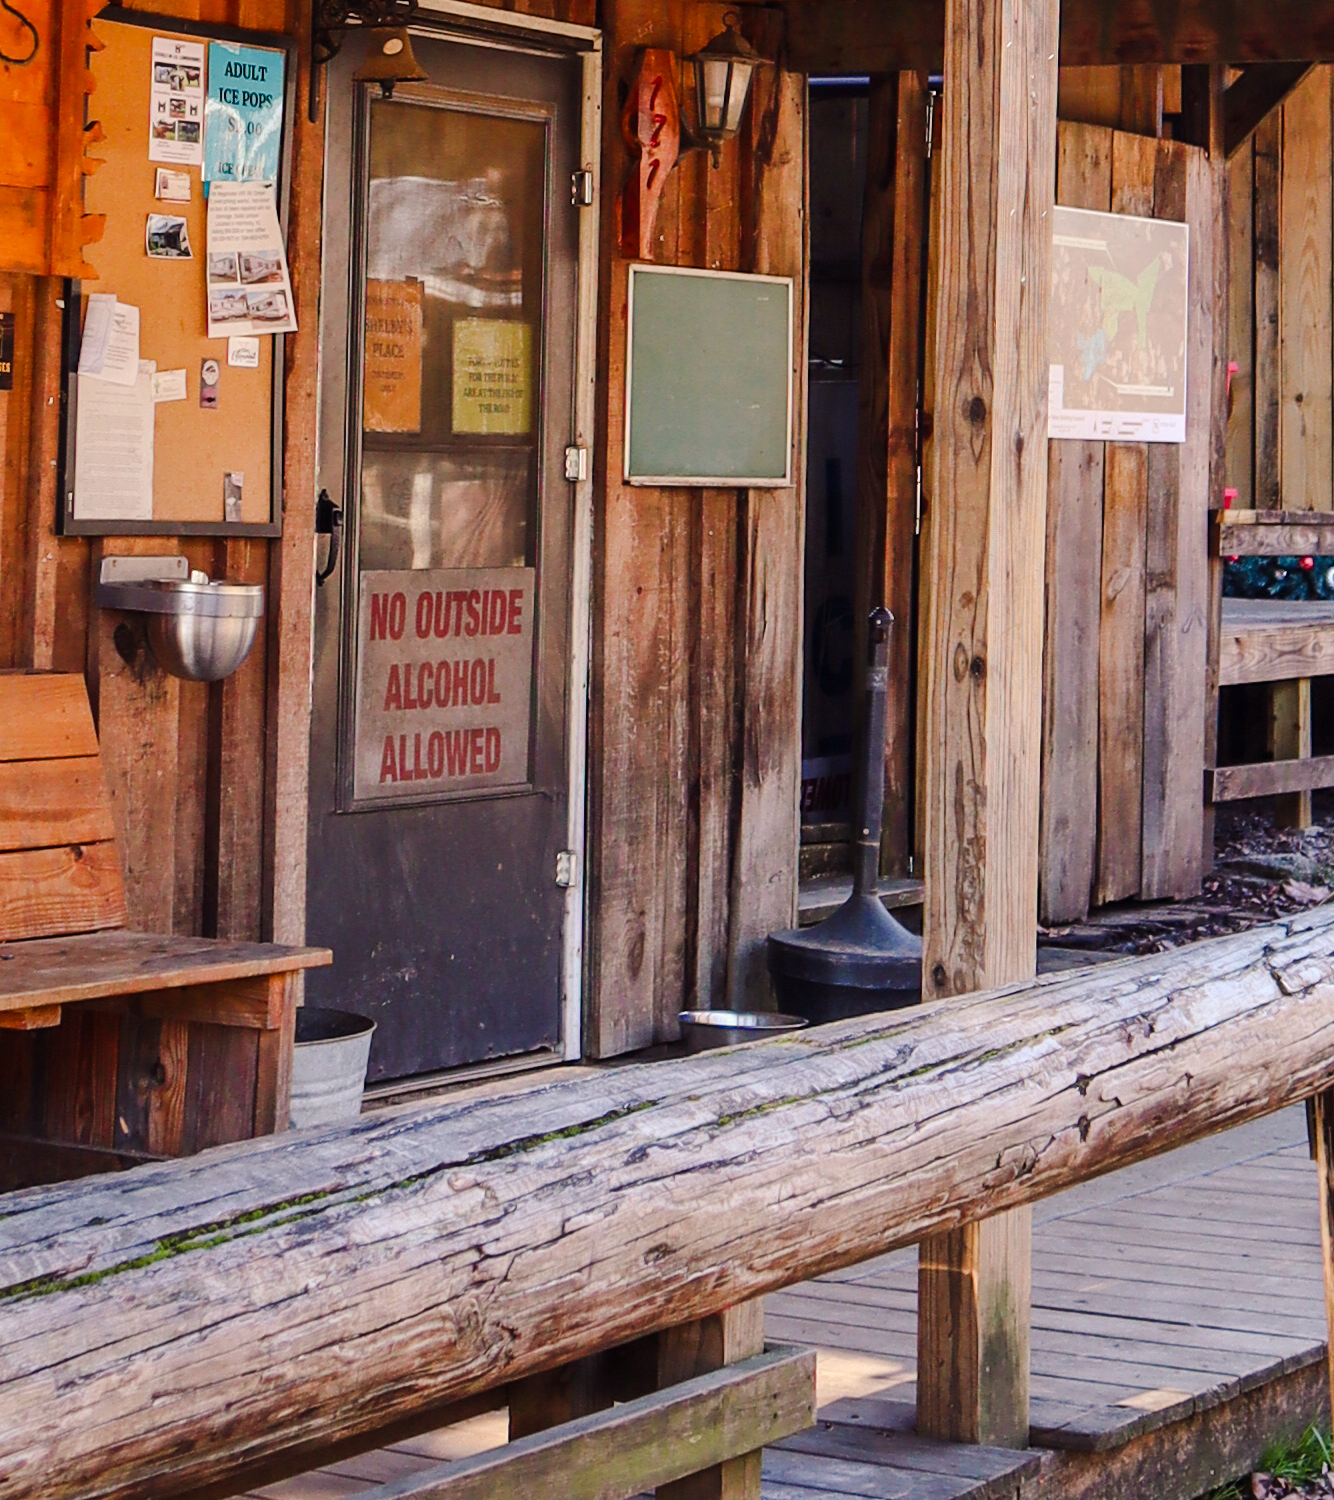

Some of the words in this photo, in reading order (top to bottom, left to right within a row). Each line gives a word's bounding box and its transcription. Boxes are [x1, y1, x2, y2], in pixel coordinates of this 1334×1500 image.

[224, 60, 267, 82] ADULT
[218, 87, 240, 106] ICE
[242, 91, 273, 110] POPS
[372, 343, 404, 358] PLACE
[369, 591, 407, 641] NO
[415, 589, 523, 639] OUTSIDE
[383, 657, 501, 712] ALCOHOL
[379, 726, 501, 784] ALLOWED
